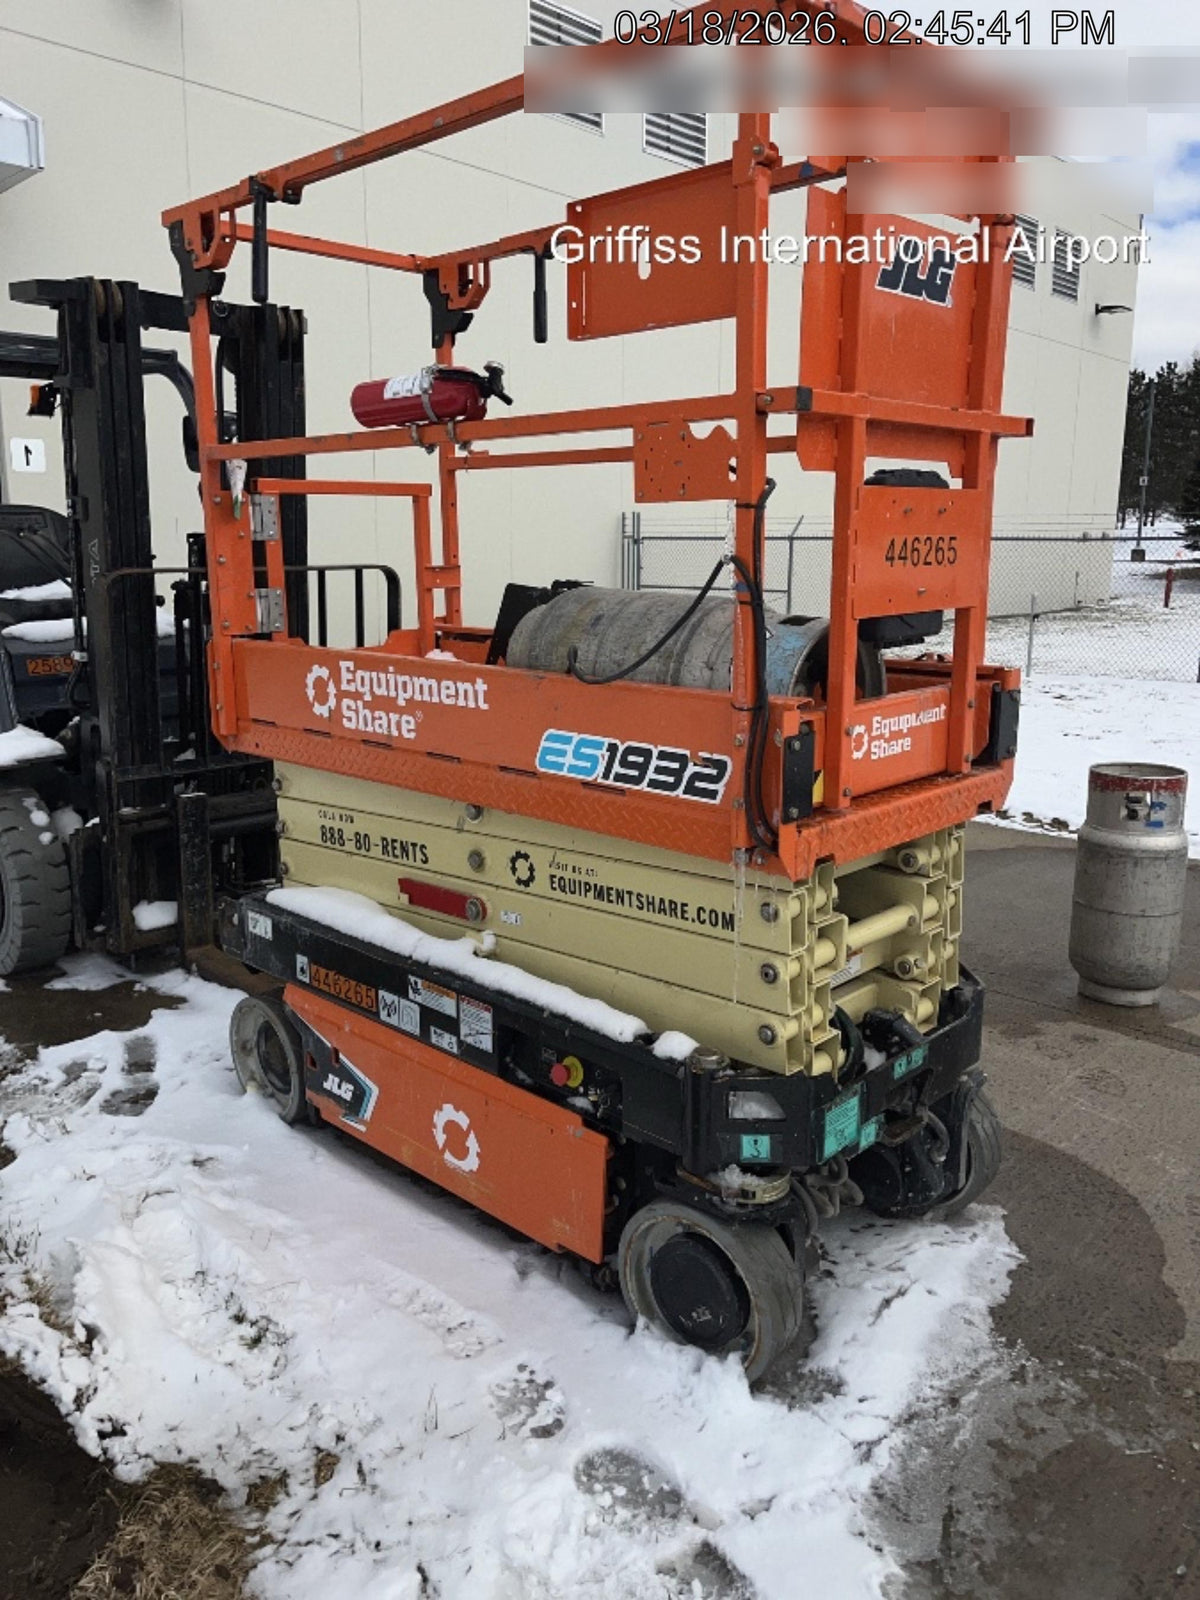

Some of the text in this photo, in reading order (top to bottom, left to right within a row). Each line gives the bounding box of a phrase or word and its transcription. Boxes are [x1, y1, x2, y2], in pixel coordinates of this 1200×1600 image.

[874, 235, 960, 308] JLG
[884, 535, 958, 568] 446265
[338, 660, 490, 711] Equipment
[340, 698, 417, 740] Share
[536, 728, 733, 805] ES1932
[870, 736, 912, 760] Share
[319, 824, 430, 865] 888-80-RENTS
[548, 873, 736, 933] EQUIPMENTSHARE.COM
[311, 966, 376, 1009] 446265
[322, 1072, 356, 1102] JLG
